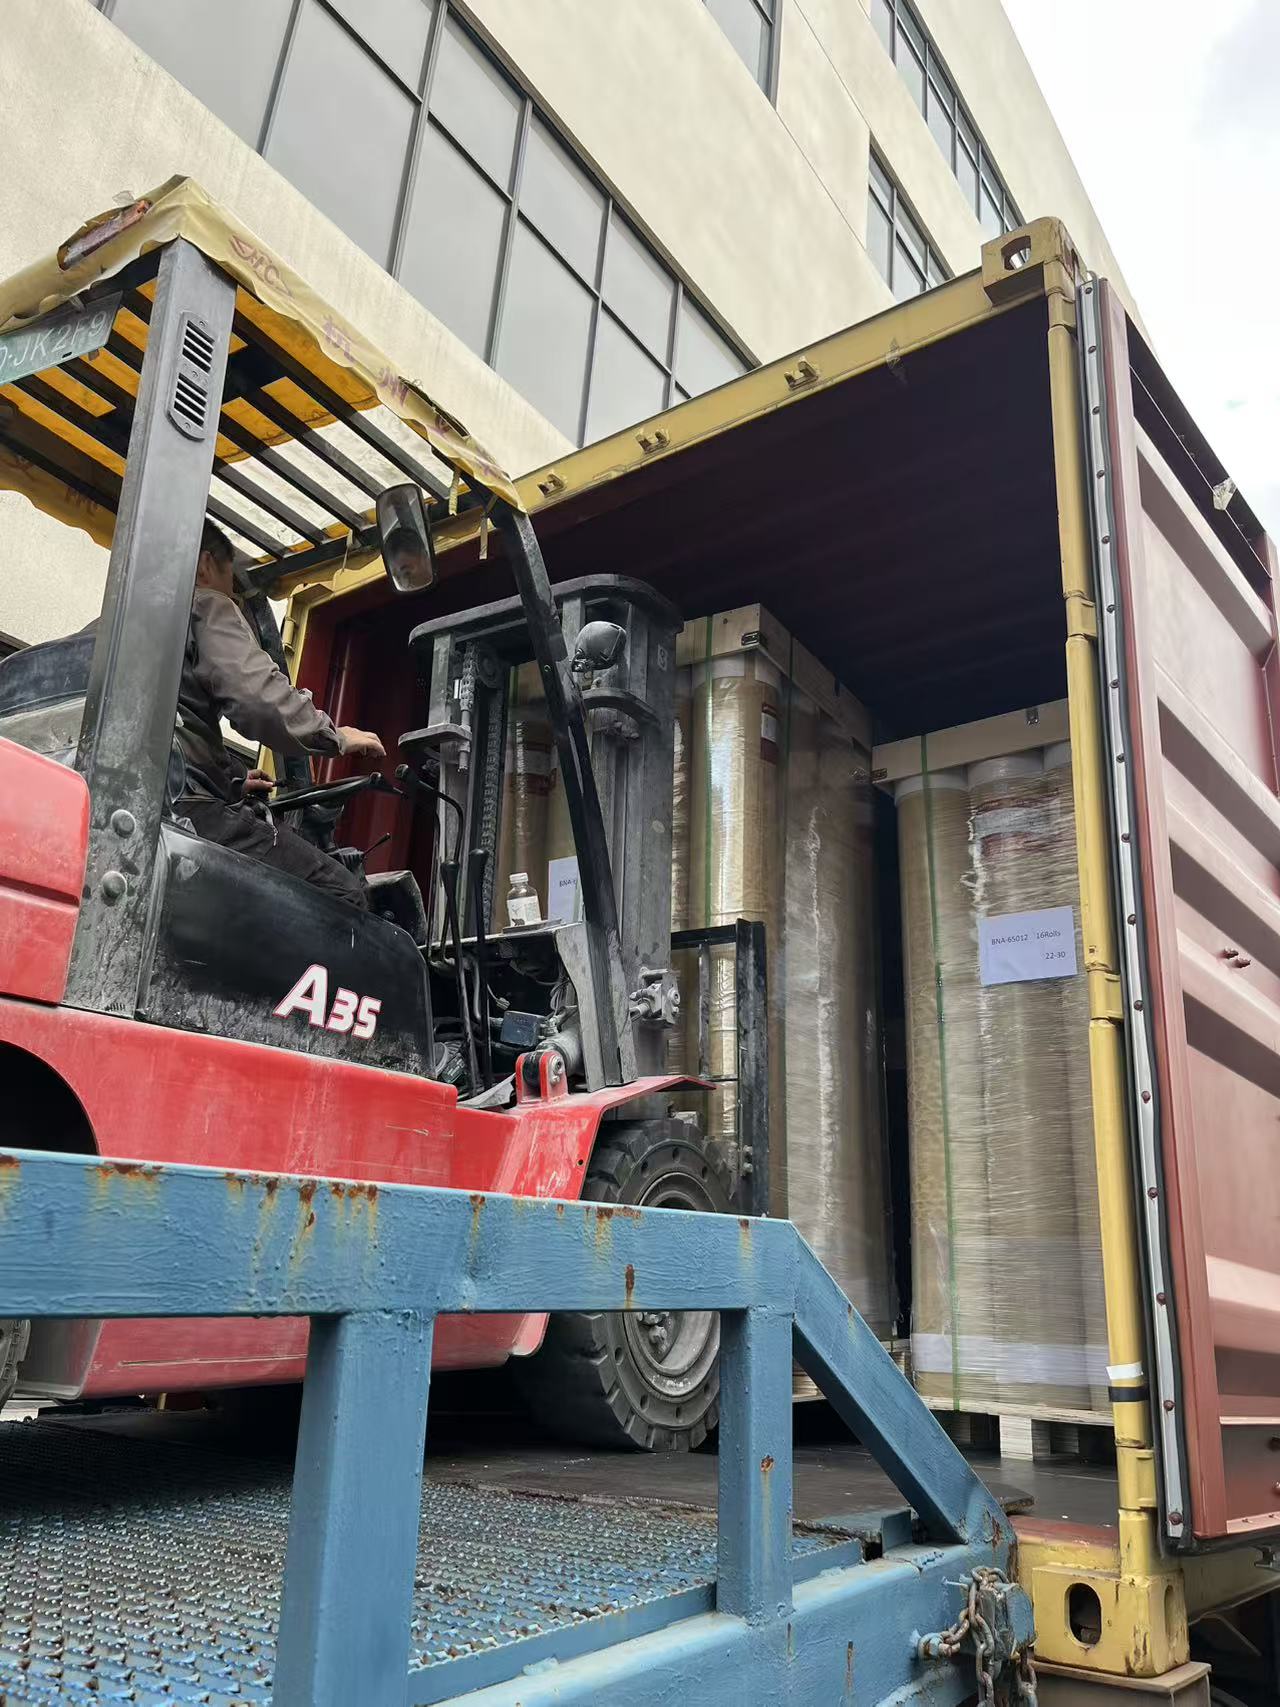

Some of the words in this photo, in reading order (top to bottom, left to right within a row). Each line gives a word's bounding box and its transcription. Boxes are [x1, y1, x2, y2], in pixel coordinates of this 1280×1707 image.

[991, 934, 1028, 945] BNA-65012
[1036, 930, 1061, 939] 16Rolls
[1045, 951, 1066, 959] 22-30
[271, 963, 382, 1041] A35
